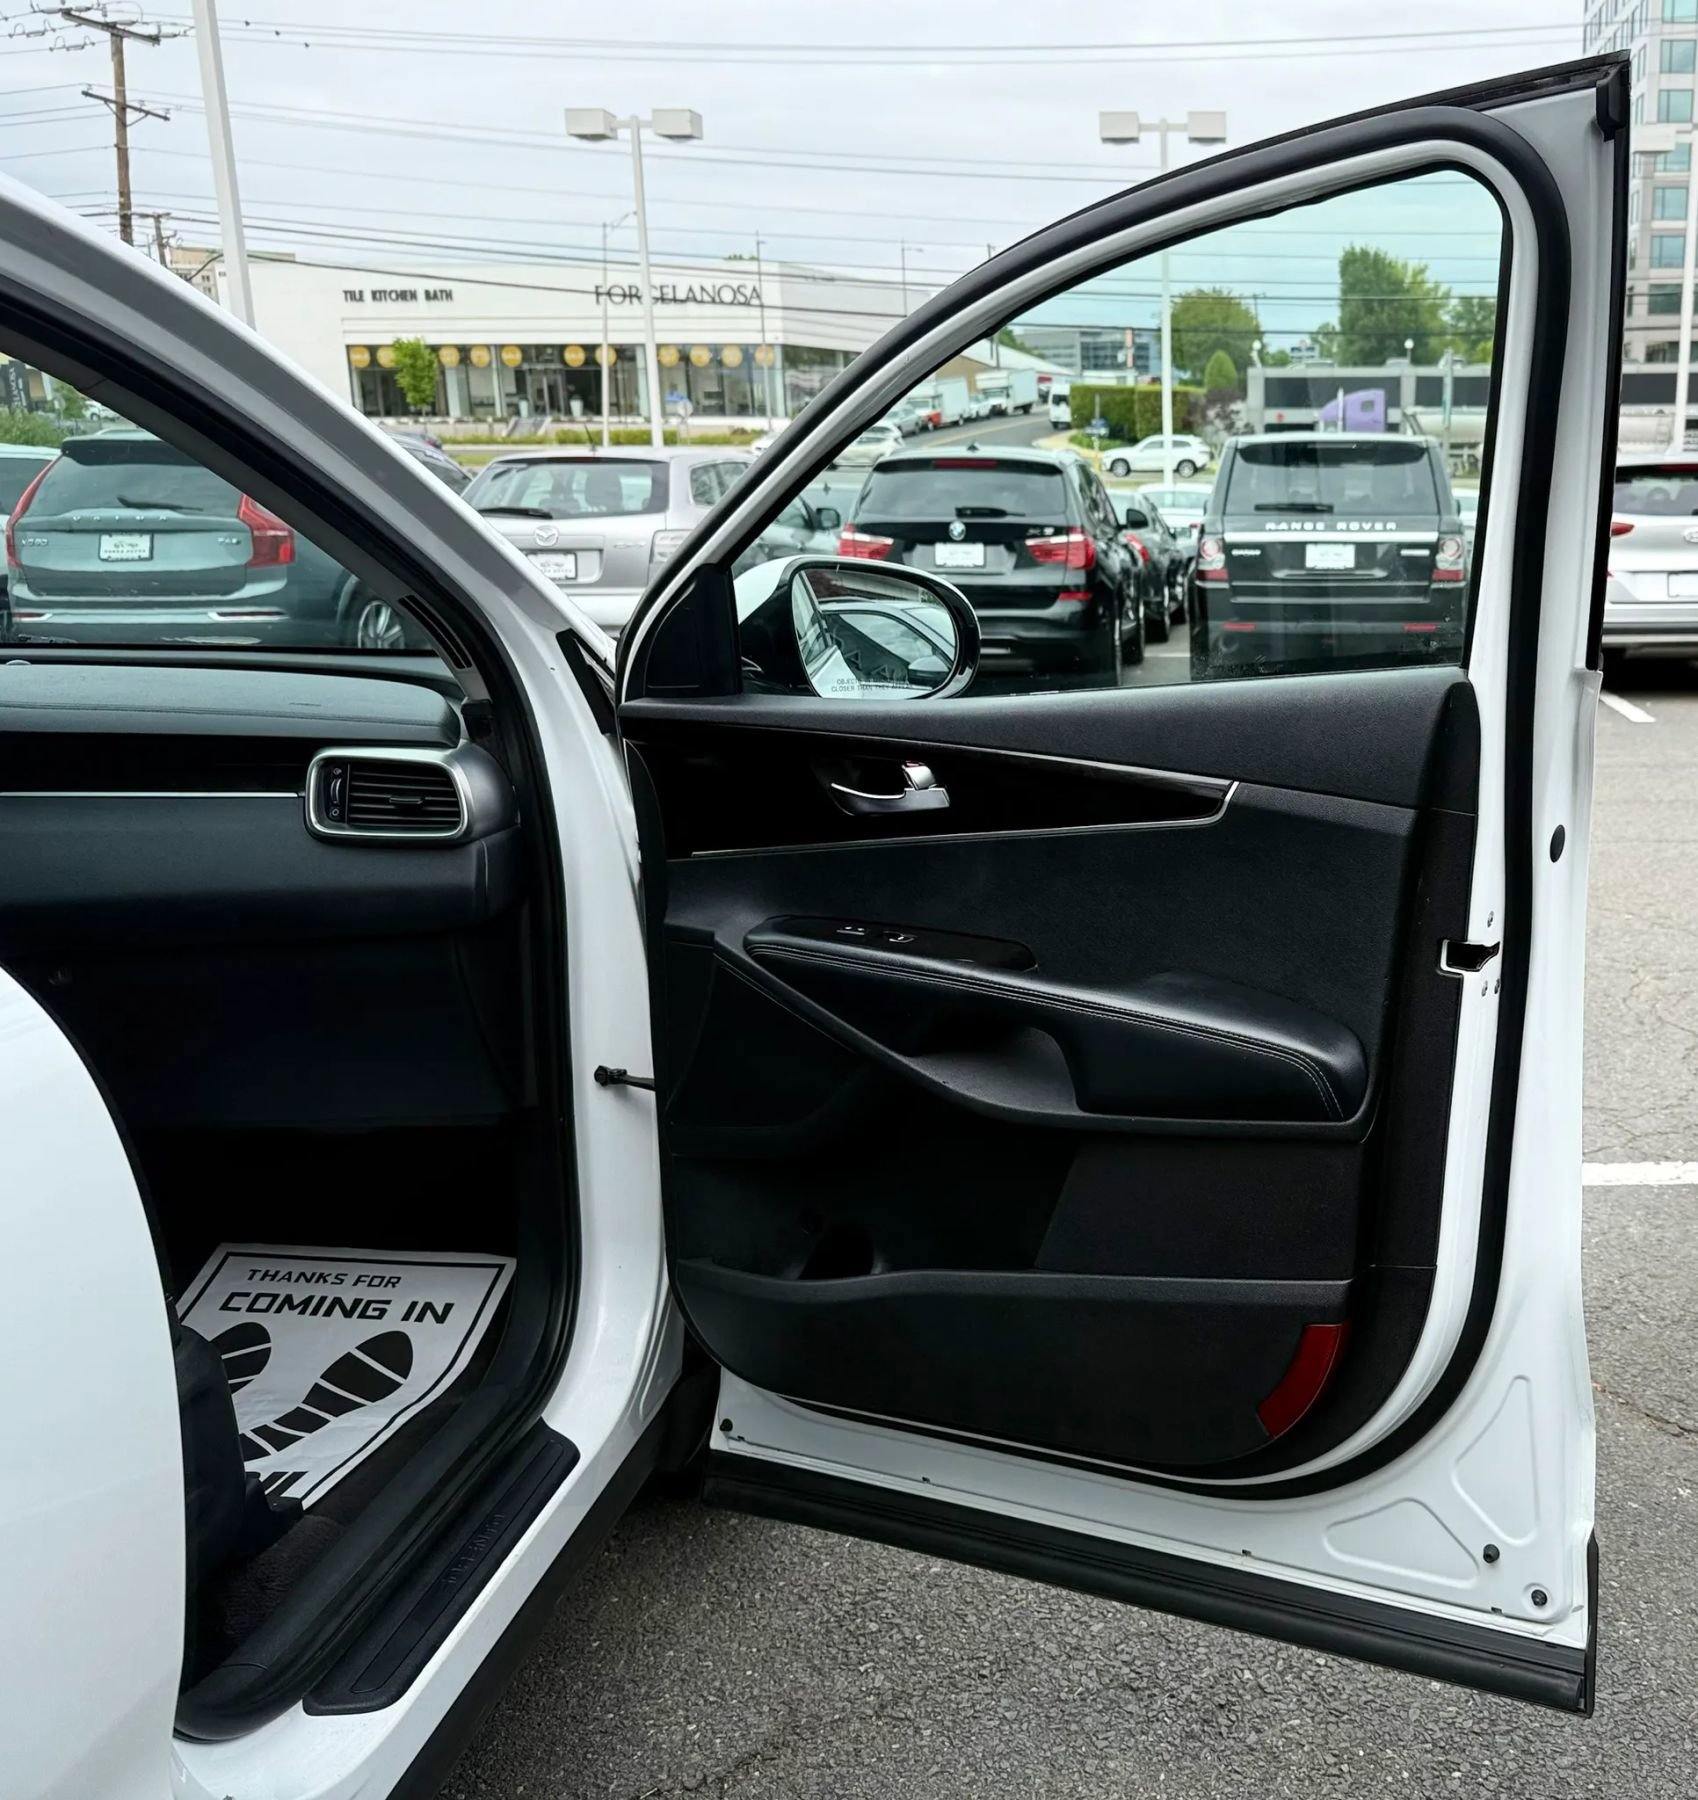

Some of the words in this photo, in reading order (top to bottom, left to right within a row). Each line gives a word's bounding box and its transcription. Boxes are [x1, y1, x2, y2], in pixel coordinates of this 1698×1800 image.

[342, 289, 366, 303] TILE
[370, 288, 418, 303] KITCHEN
[423, 288, 454, 303] BATH
[1264, 521, 1326, 531] RANGE
[1335, 521, 1398, 531] ROVER
[248, 1268, 348, 1285] THANKS
[352, 1274, 402, 1289] FOR
[218, 1291, 393, 1320] COMING
[400, 1300, 455, 1324] IN
